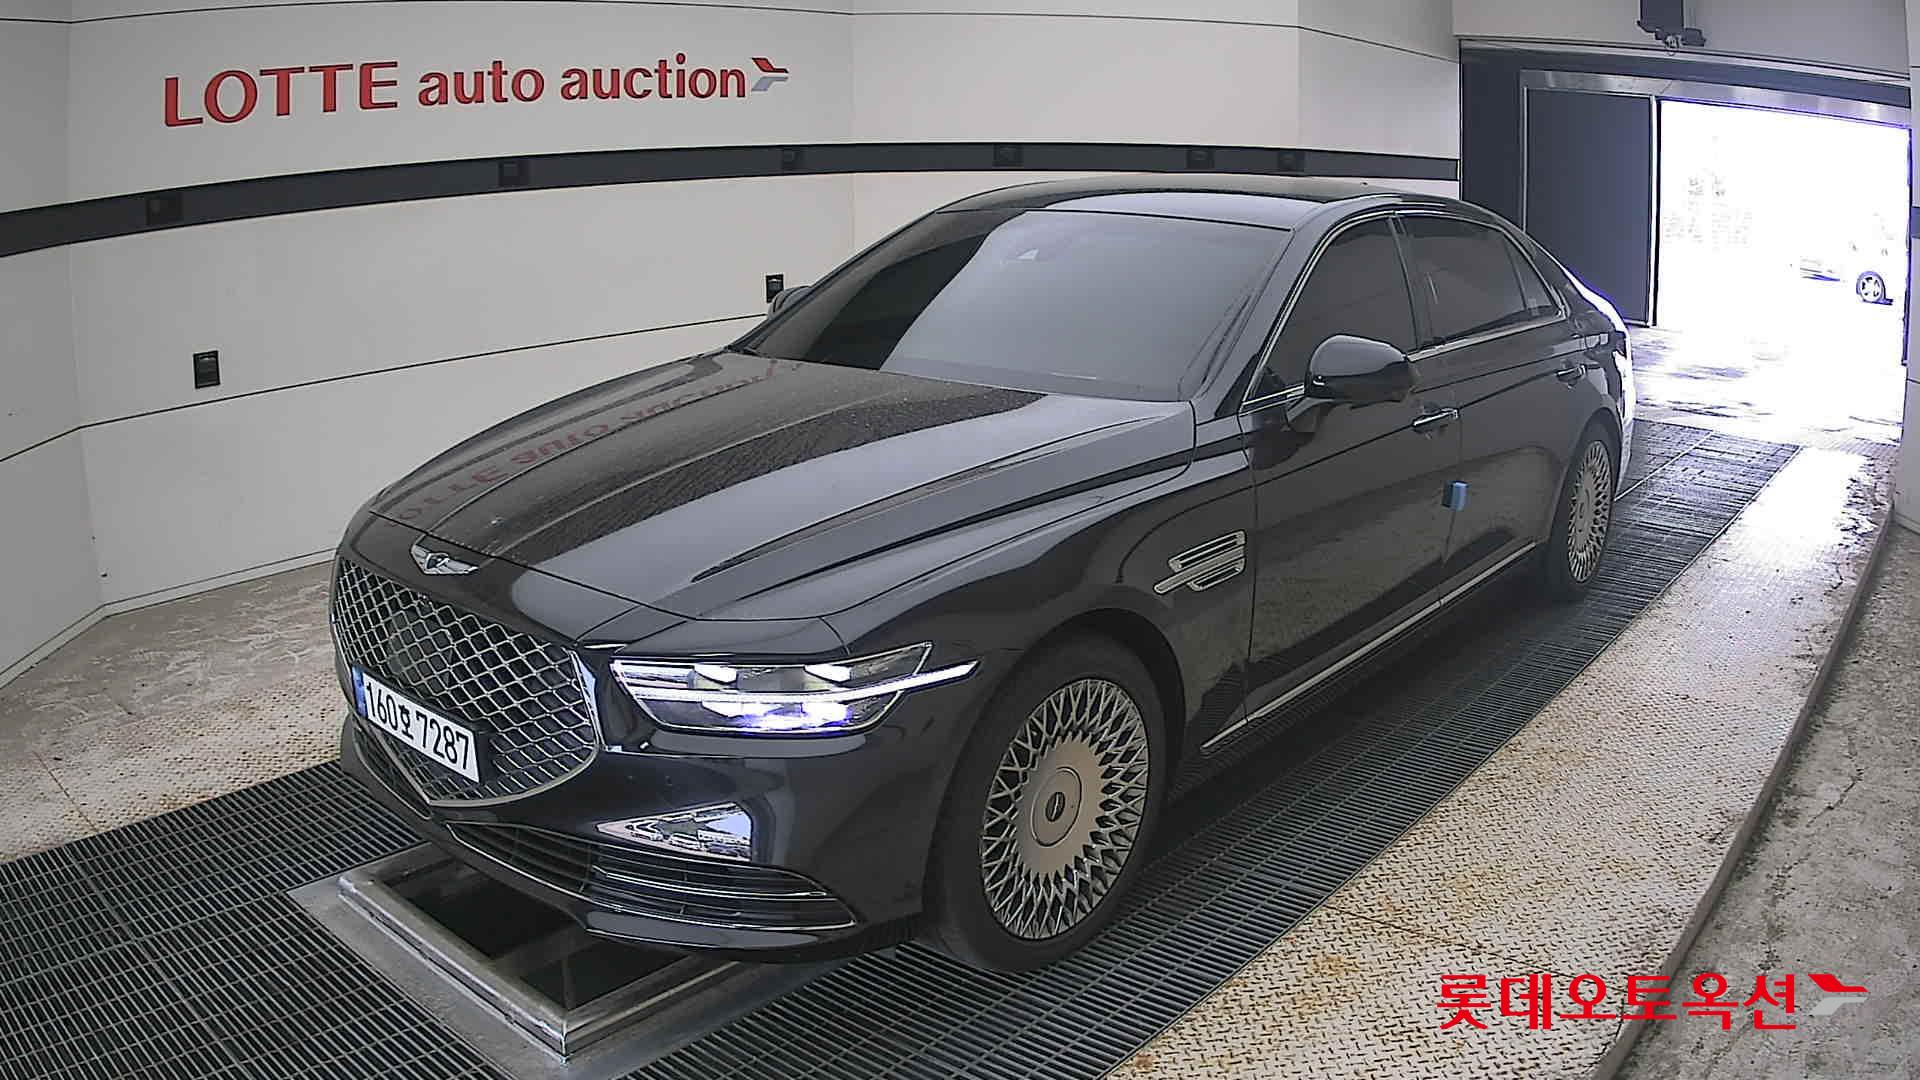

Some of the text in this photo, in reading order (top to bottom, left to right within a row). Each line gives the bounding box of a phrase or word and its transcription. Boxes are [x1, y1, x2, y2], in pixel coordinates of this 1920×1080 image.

[164, 53, 747, 127] LOTTE auto auction
